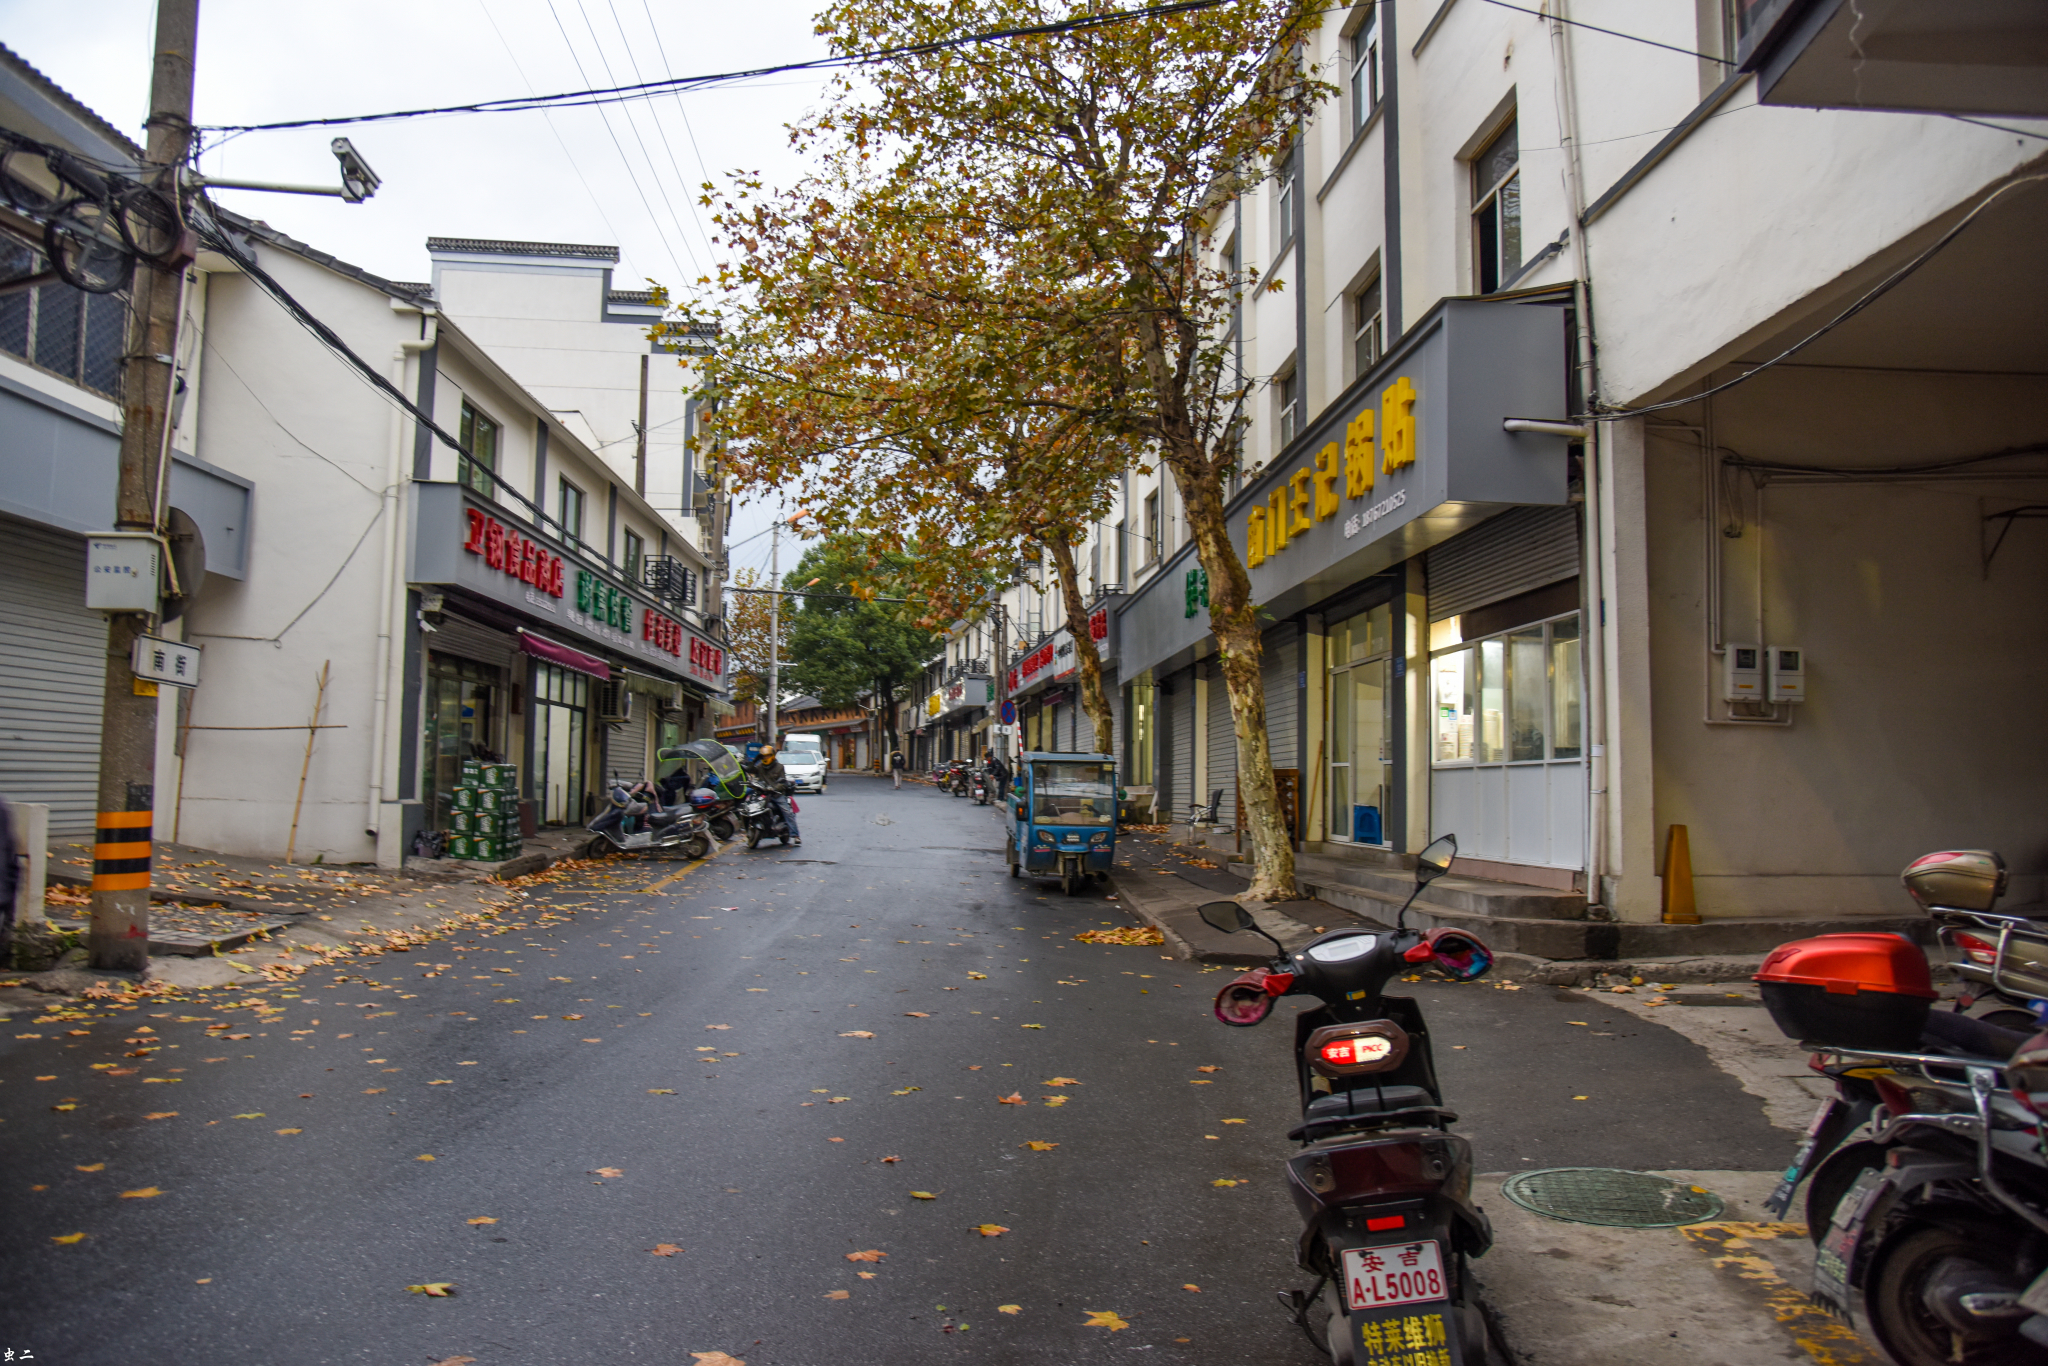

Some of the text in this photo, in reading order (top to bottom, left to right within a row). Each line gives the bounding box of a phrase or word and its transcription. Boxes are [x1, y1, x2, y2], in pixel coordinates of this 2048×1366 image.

[1247, 376, 1416, 569] 南门王记锅贴
[1326, 1046, 1350, 1059] 安吉
[1361, 1250, 1421, 1271] 安吉
[1362, 1314, 1446, 1355] 特莱维狮
